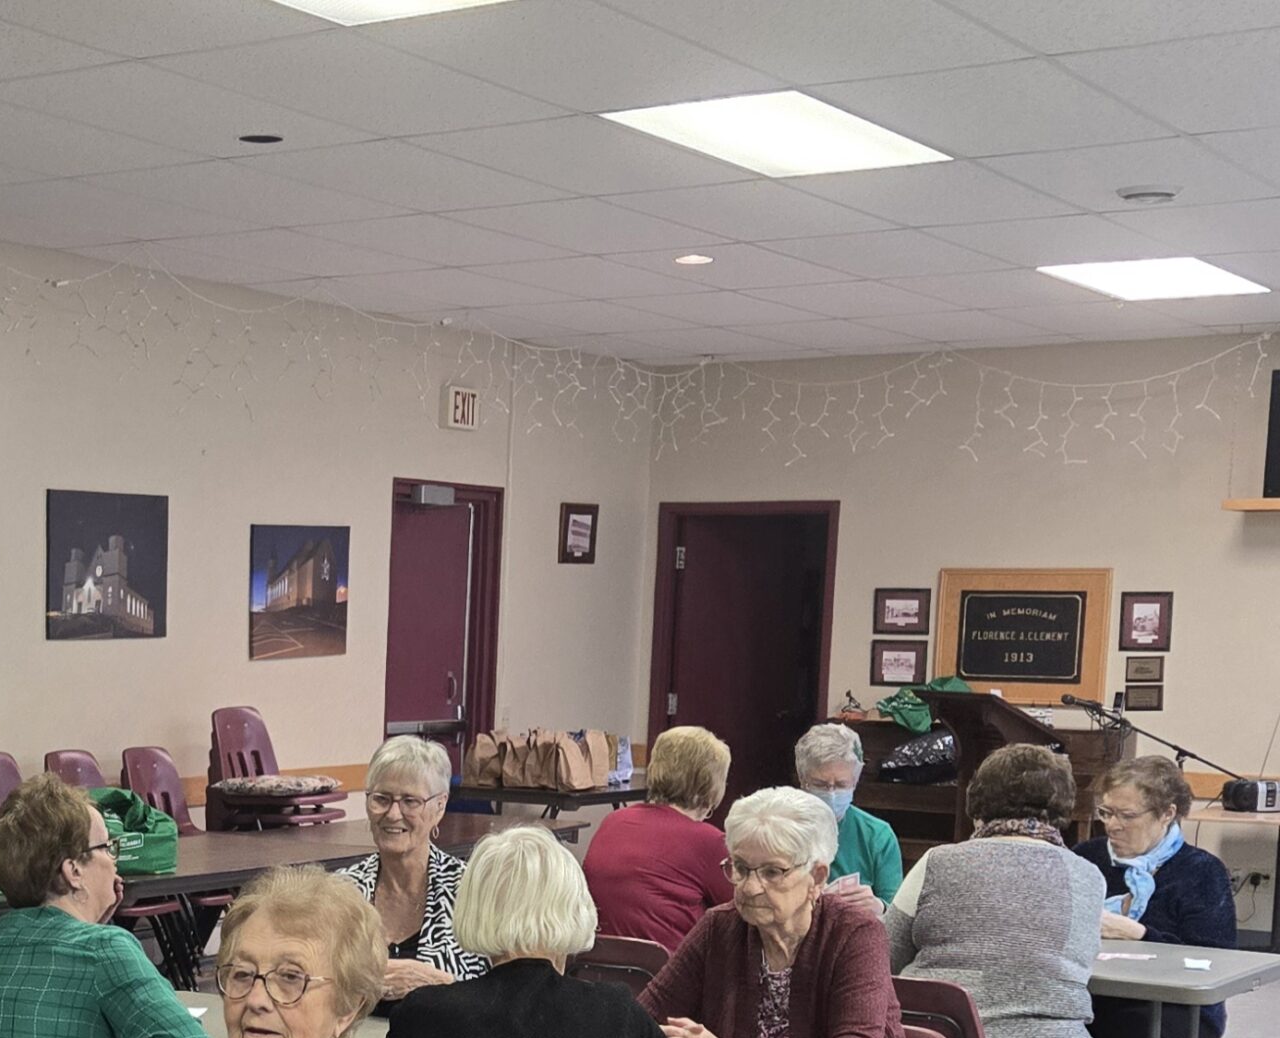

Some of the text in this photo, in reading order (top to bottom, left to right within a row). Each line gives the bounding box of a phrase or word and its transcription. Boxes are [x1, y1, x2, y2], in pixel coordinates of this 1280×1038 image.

[453, 391, 477, 426] EXIT
[986, 607, 1057, 621] IN MEMORIAM
[971, 630, 1017, 641] FLORENCE
[1003, 652, 1034, 663] 1913
